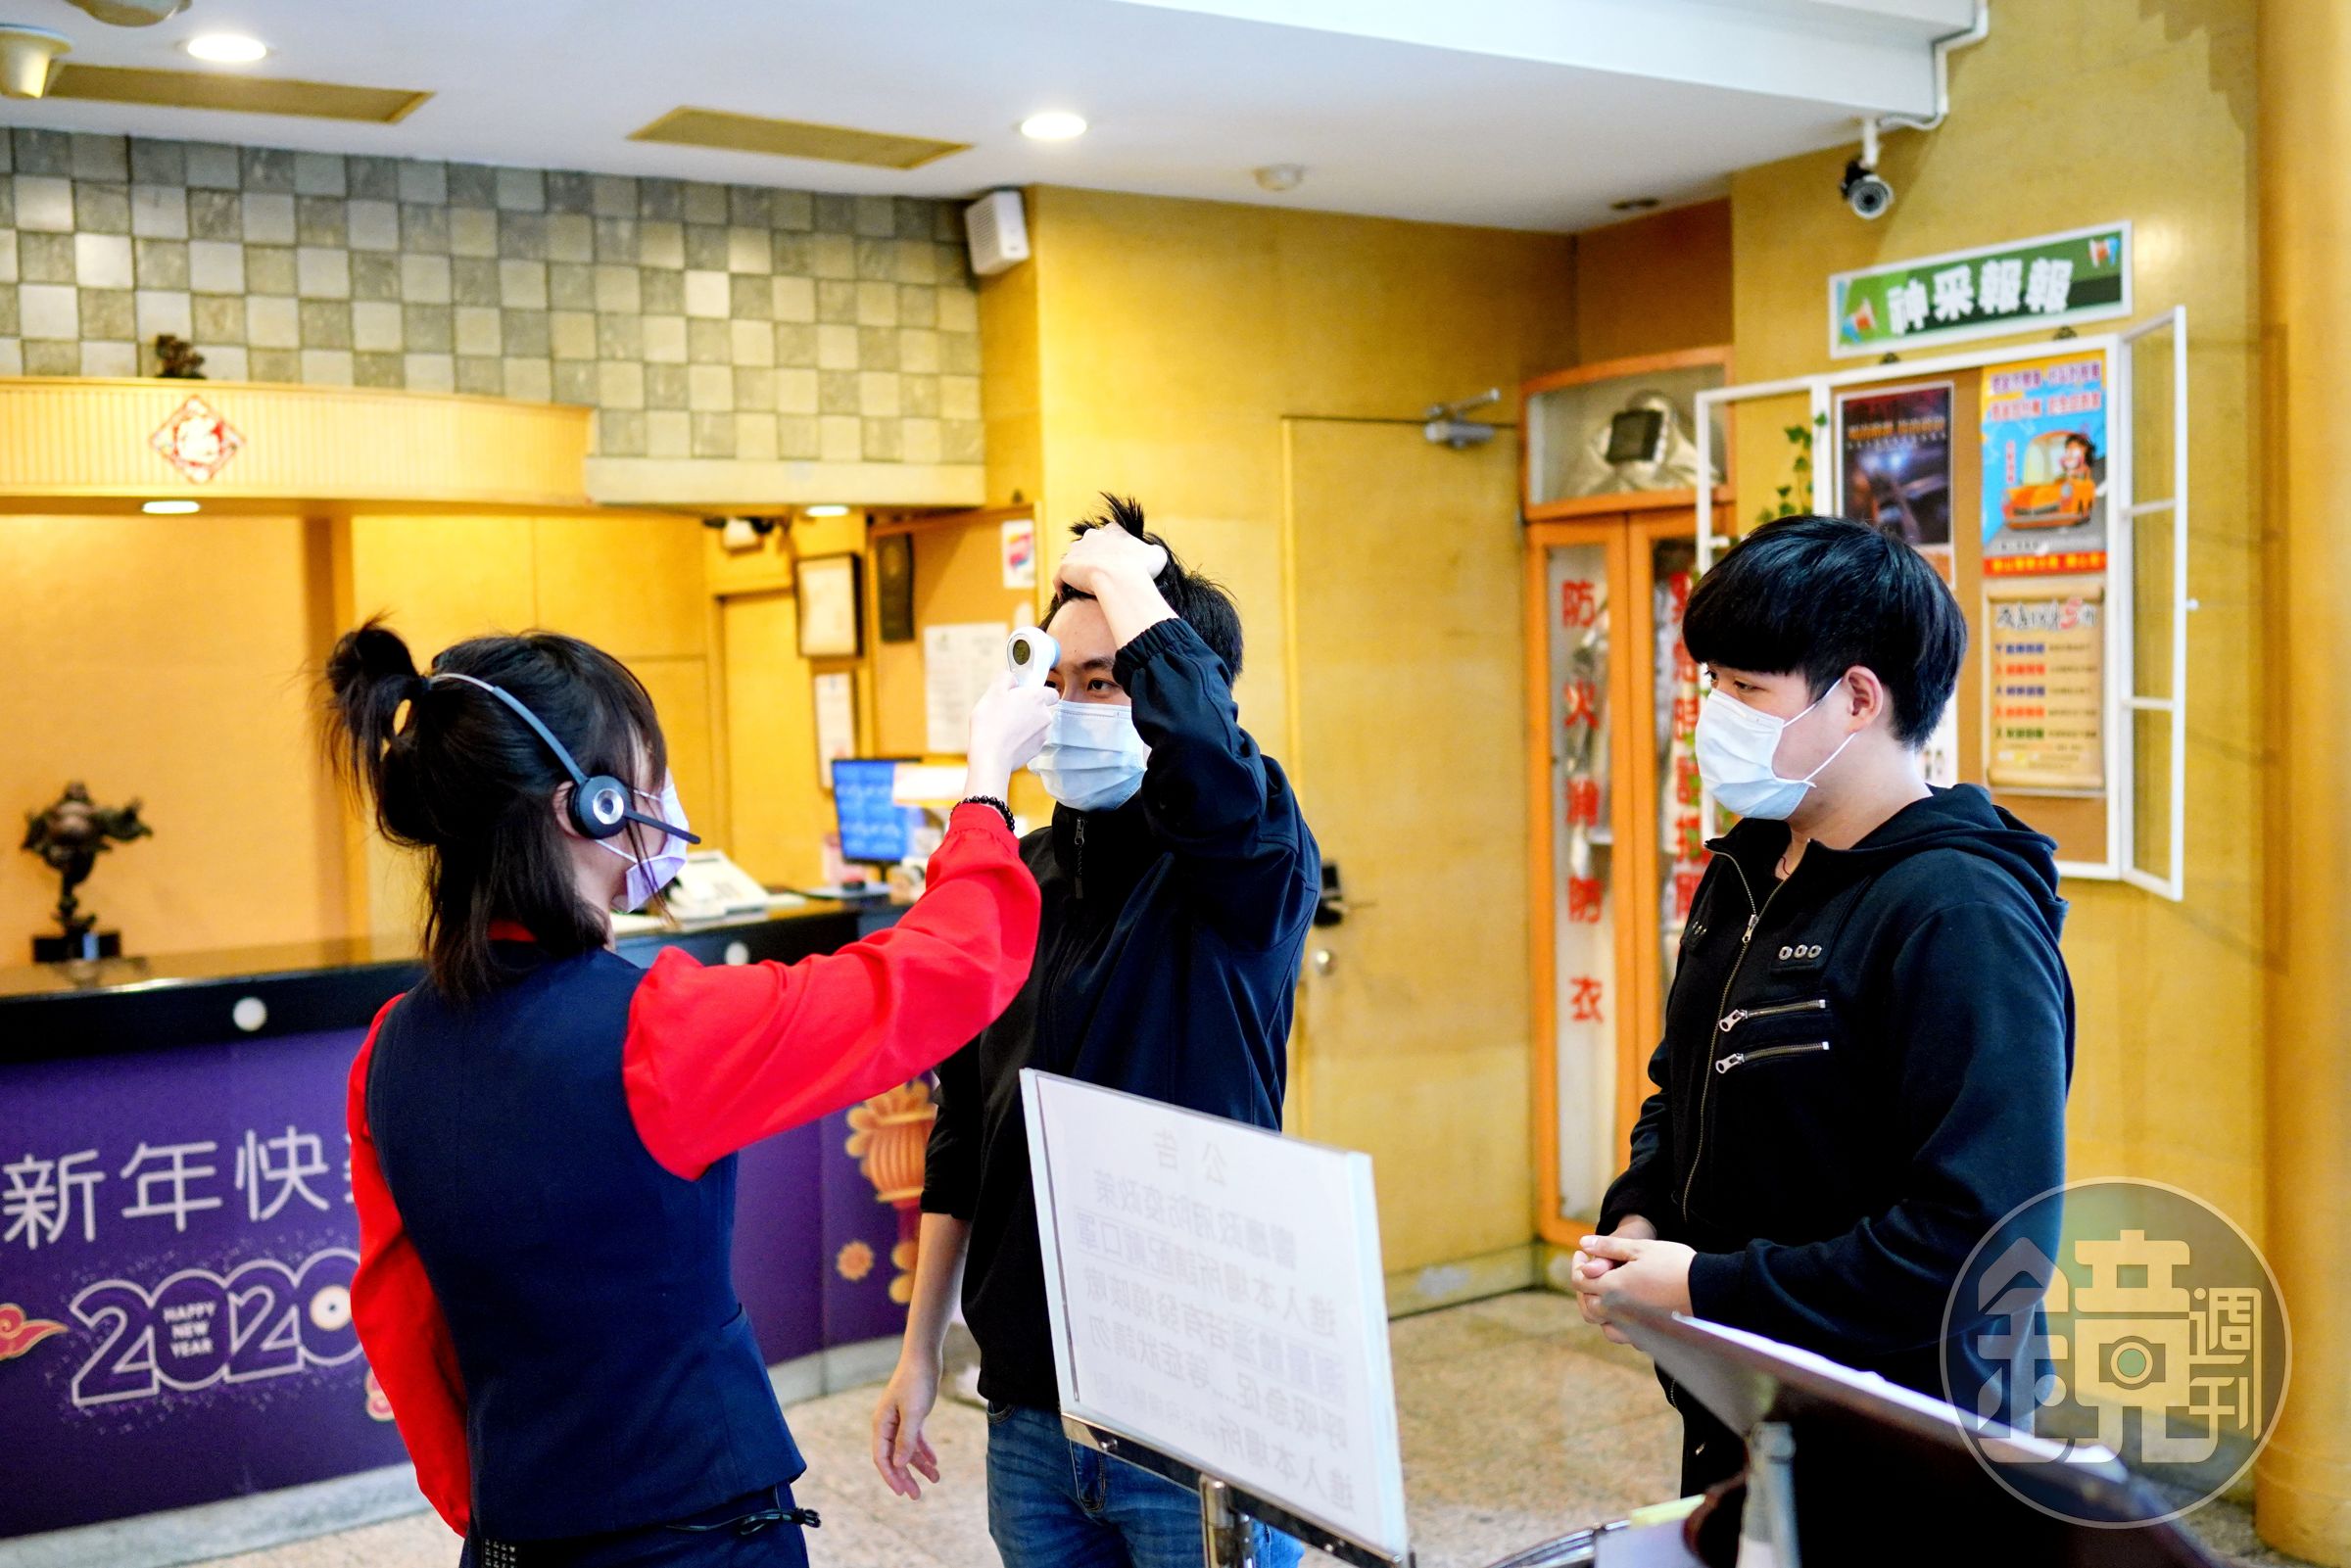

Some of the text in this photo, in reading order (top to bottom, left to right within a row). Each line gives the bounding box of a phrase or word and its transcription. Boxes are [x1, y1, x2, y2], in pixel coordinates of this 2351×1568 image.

[1887, 257, 2074, 336] 神采報報
[2, 1126, 355, 1250] 新年快
[70, 1248, 364, 1407] 2020
[163, 1301, 216, 1324] HAPPY
[171, 1320, 210, 1339] NEW
[170, 1337, 214, 1358] YEAR
